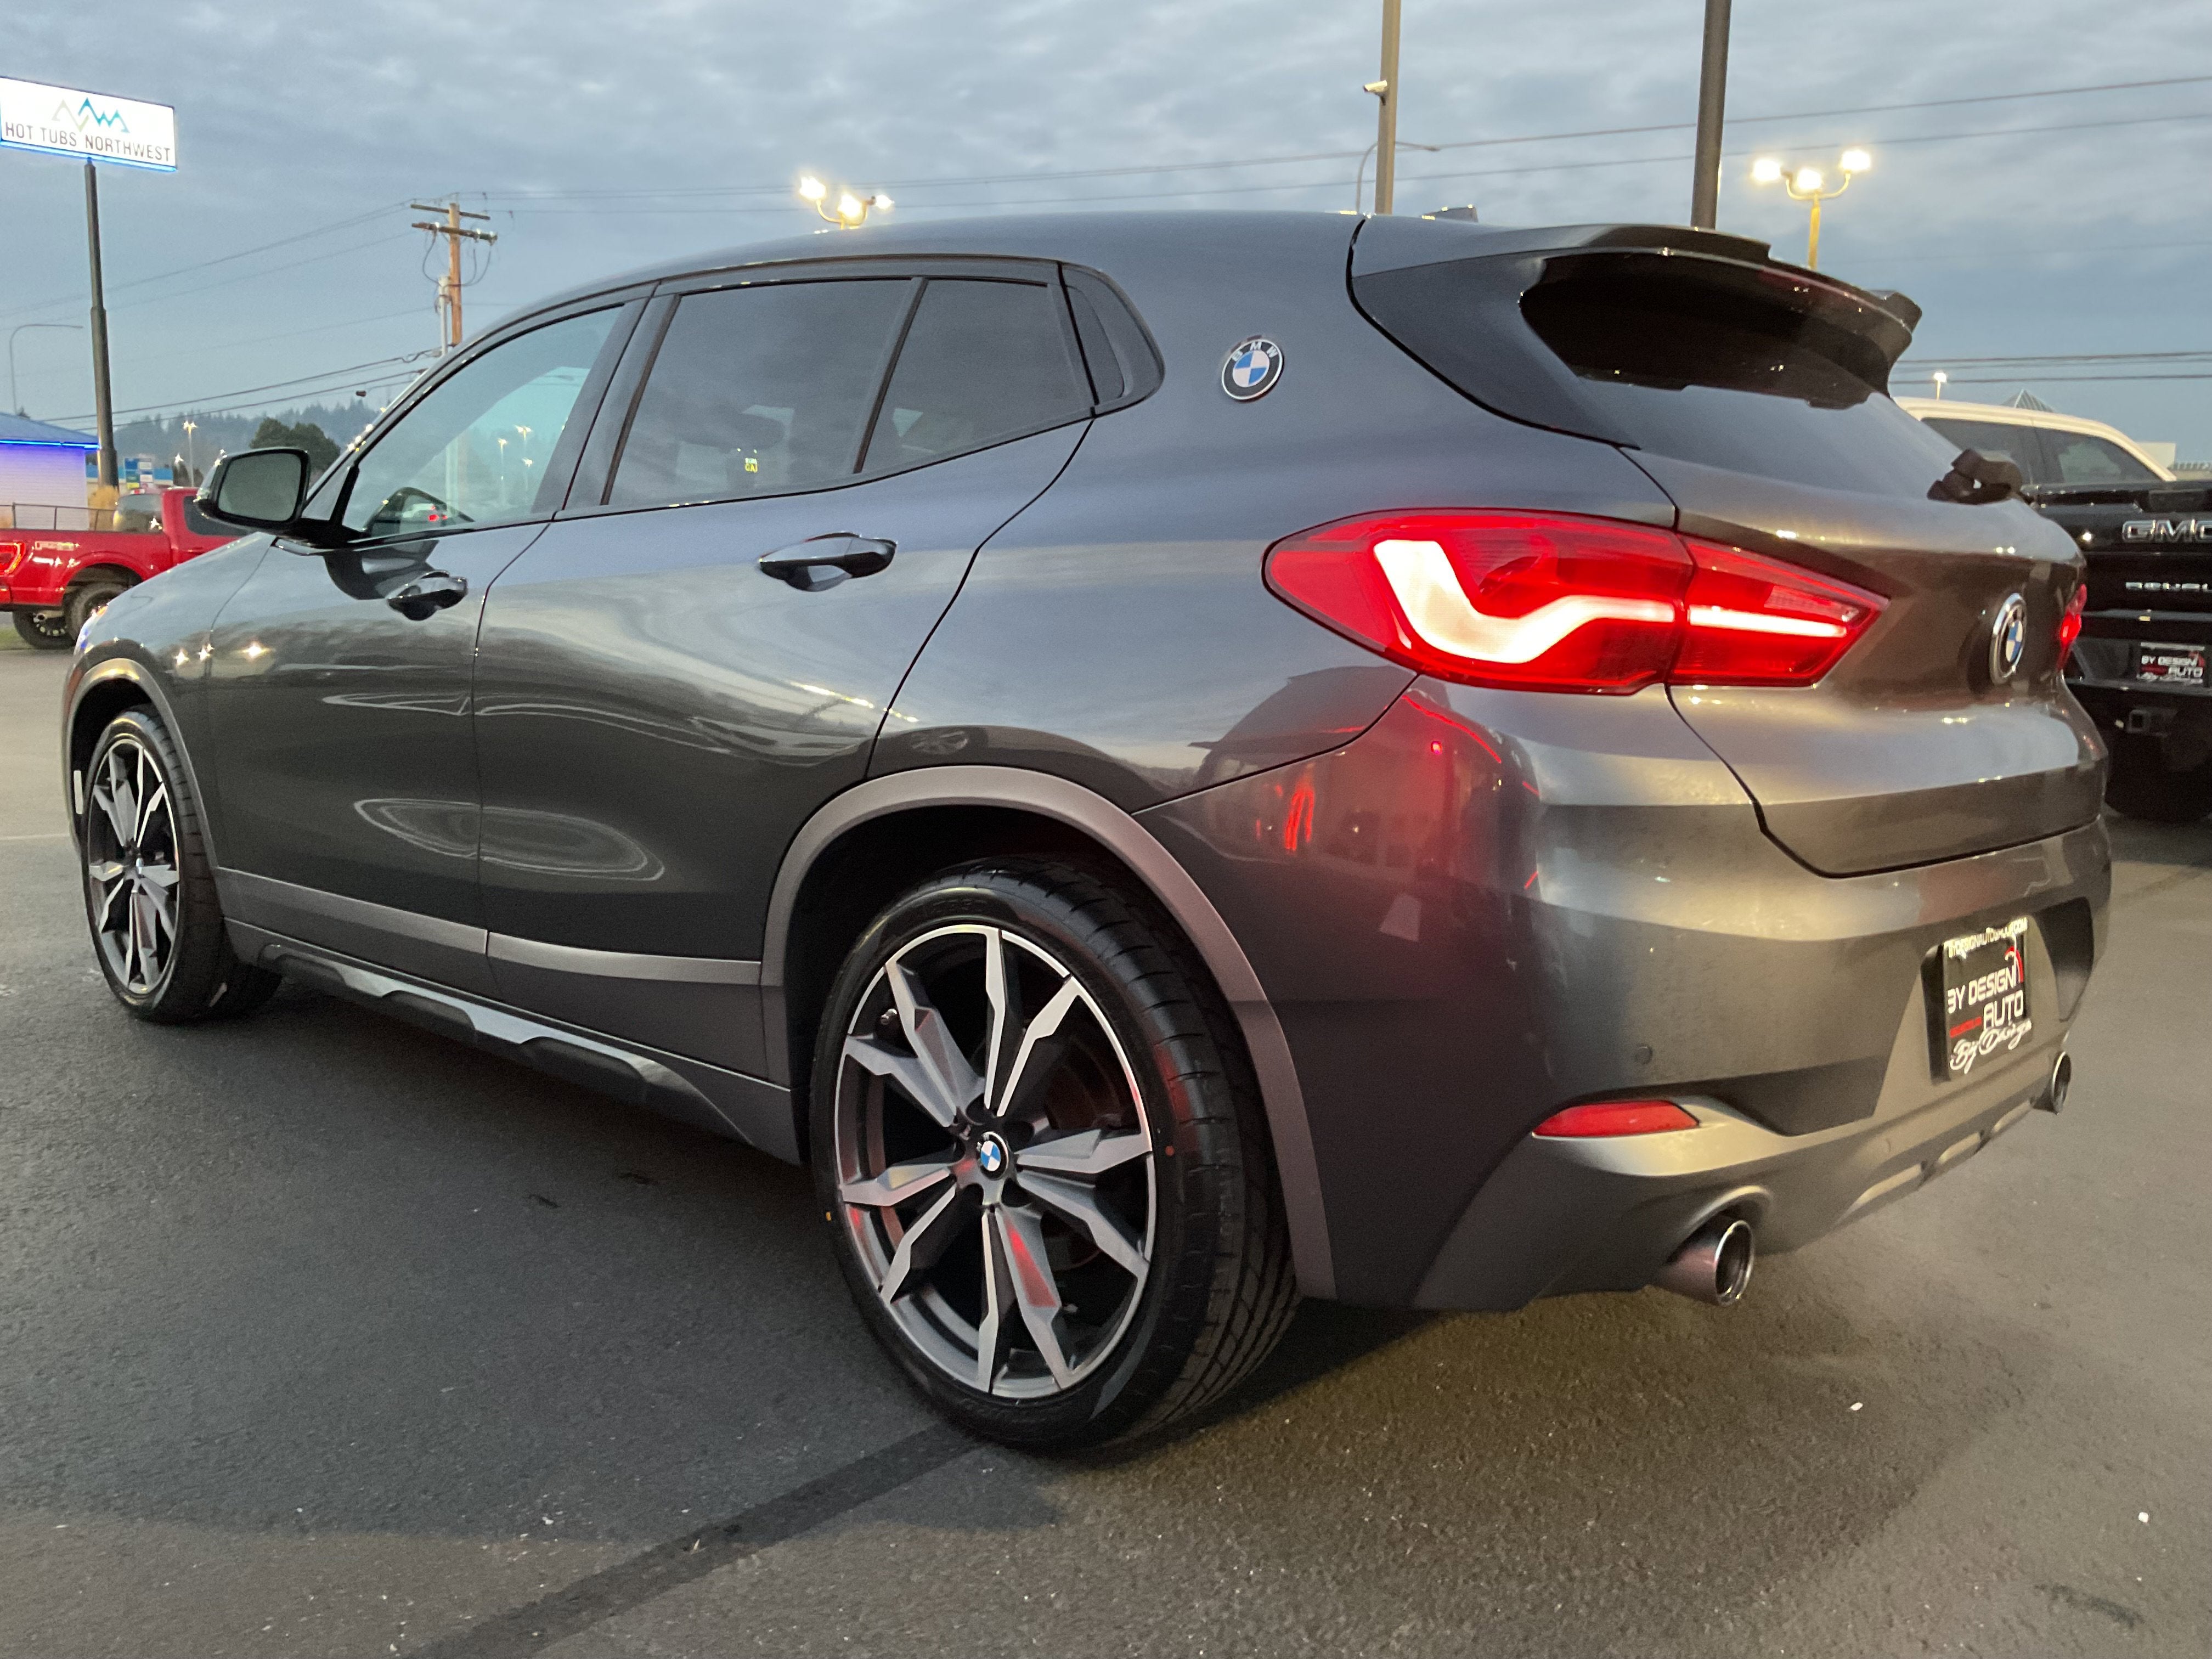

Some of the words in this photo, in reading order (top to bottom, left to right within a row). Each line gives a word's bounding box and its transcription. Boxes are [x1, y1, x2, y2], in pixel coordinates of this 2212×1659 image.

[5, 122, 33, 140] HOT
[40, 127, 77, 147] TUBS
[85, 135, 171, 162] NORTHWEST
[1231, 341, 1278, 362] BMW
[2123, 519, 2212, 543] GMC
[2168, 666, 2204, 678] AUTO
[1948, 985, 1966, 1014] BY
[1968, 964, 2017, 1006] DESIGN
[1983, 990, 2024, 1030] AUTO
